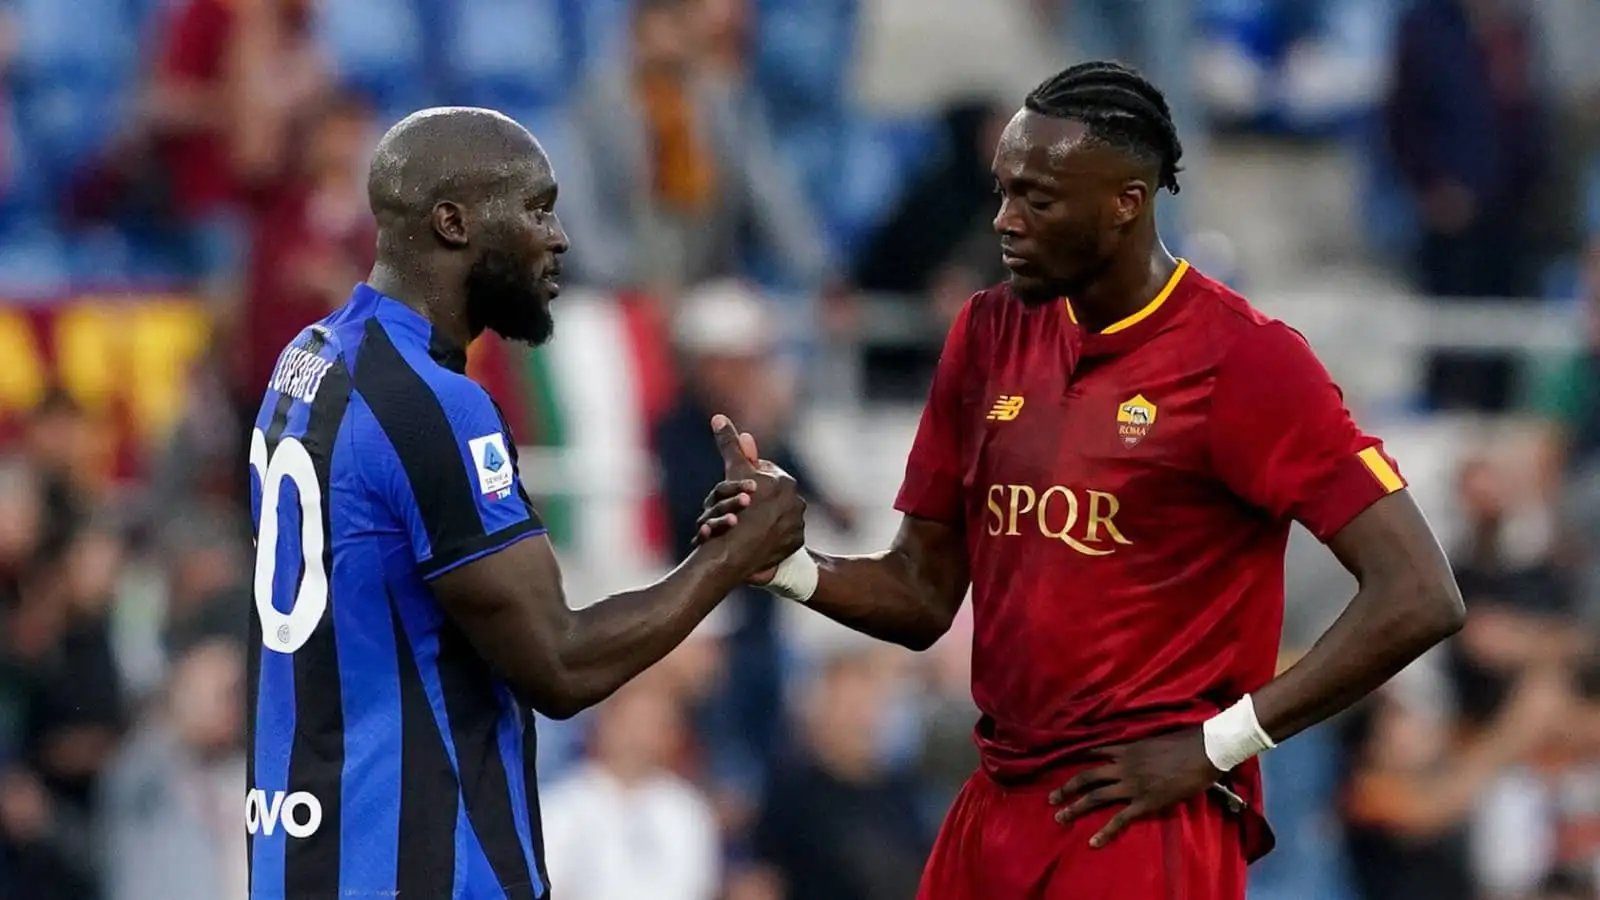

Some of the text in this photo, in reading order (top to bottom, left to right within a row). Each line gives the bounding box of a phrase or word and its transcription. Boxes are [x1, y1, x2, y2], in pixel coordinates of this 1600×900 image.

[268, 346, 333, 403] UKAKU
[1119, 424, 1146, 436] ROMA
[988, 484, 1133, 556] SPQR
